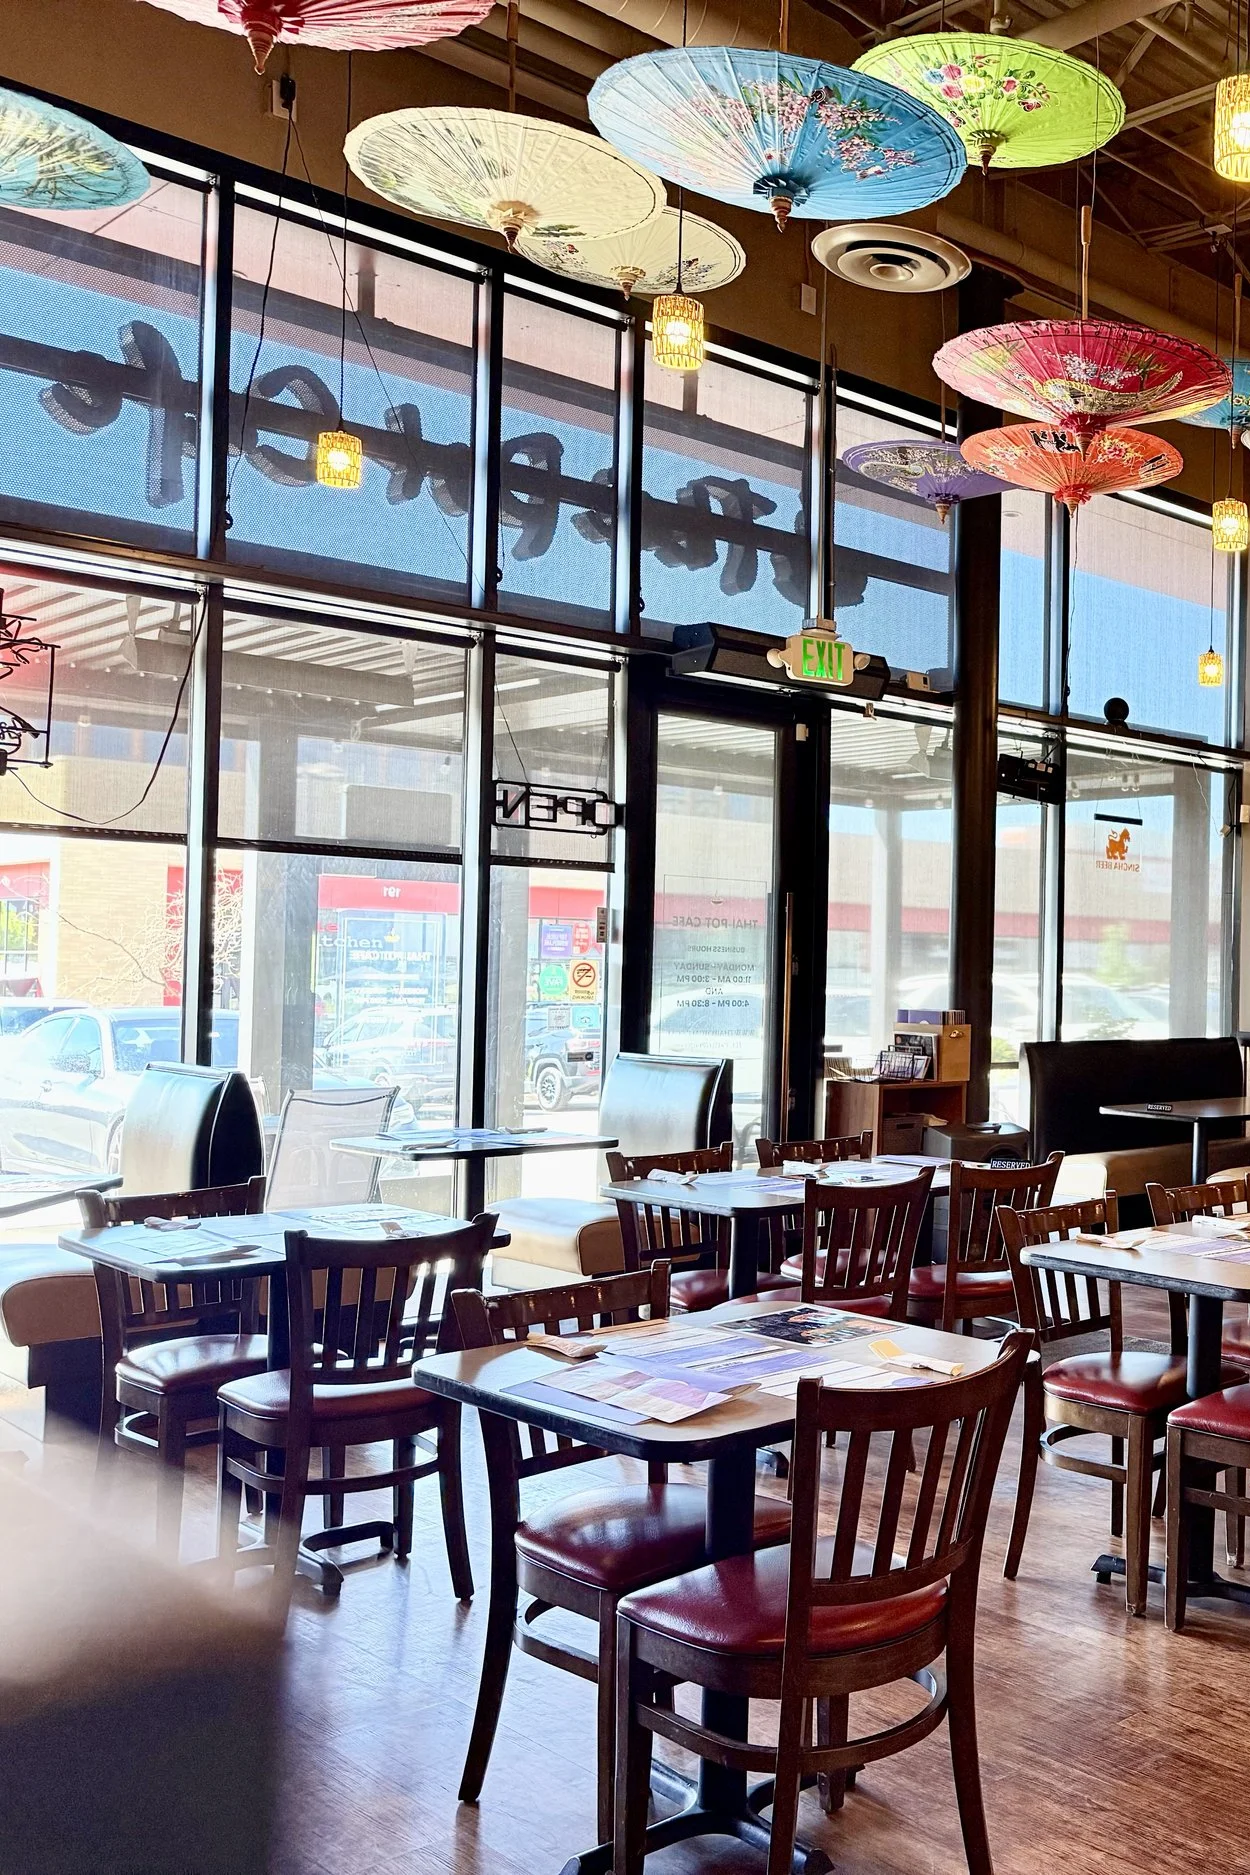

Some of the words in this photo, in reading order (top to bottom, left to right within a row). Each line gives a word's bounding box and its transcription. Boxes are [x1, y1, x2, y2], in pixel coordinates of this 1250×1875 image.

[802, 638, 845, 680] EXIT
[318, 935, 384, 949] tchen
[992, 1160, 1031, 1169] RESERVED
